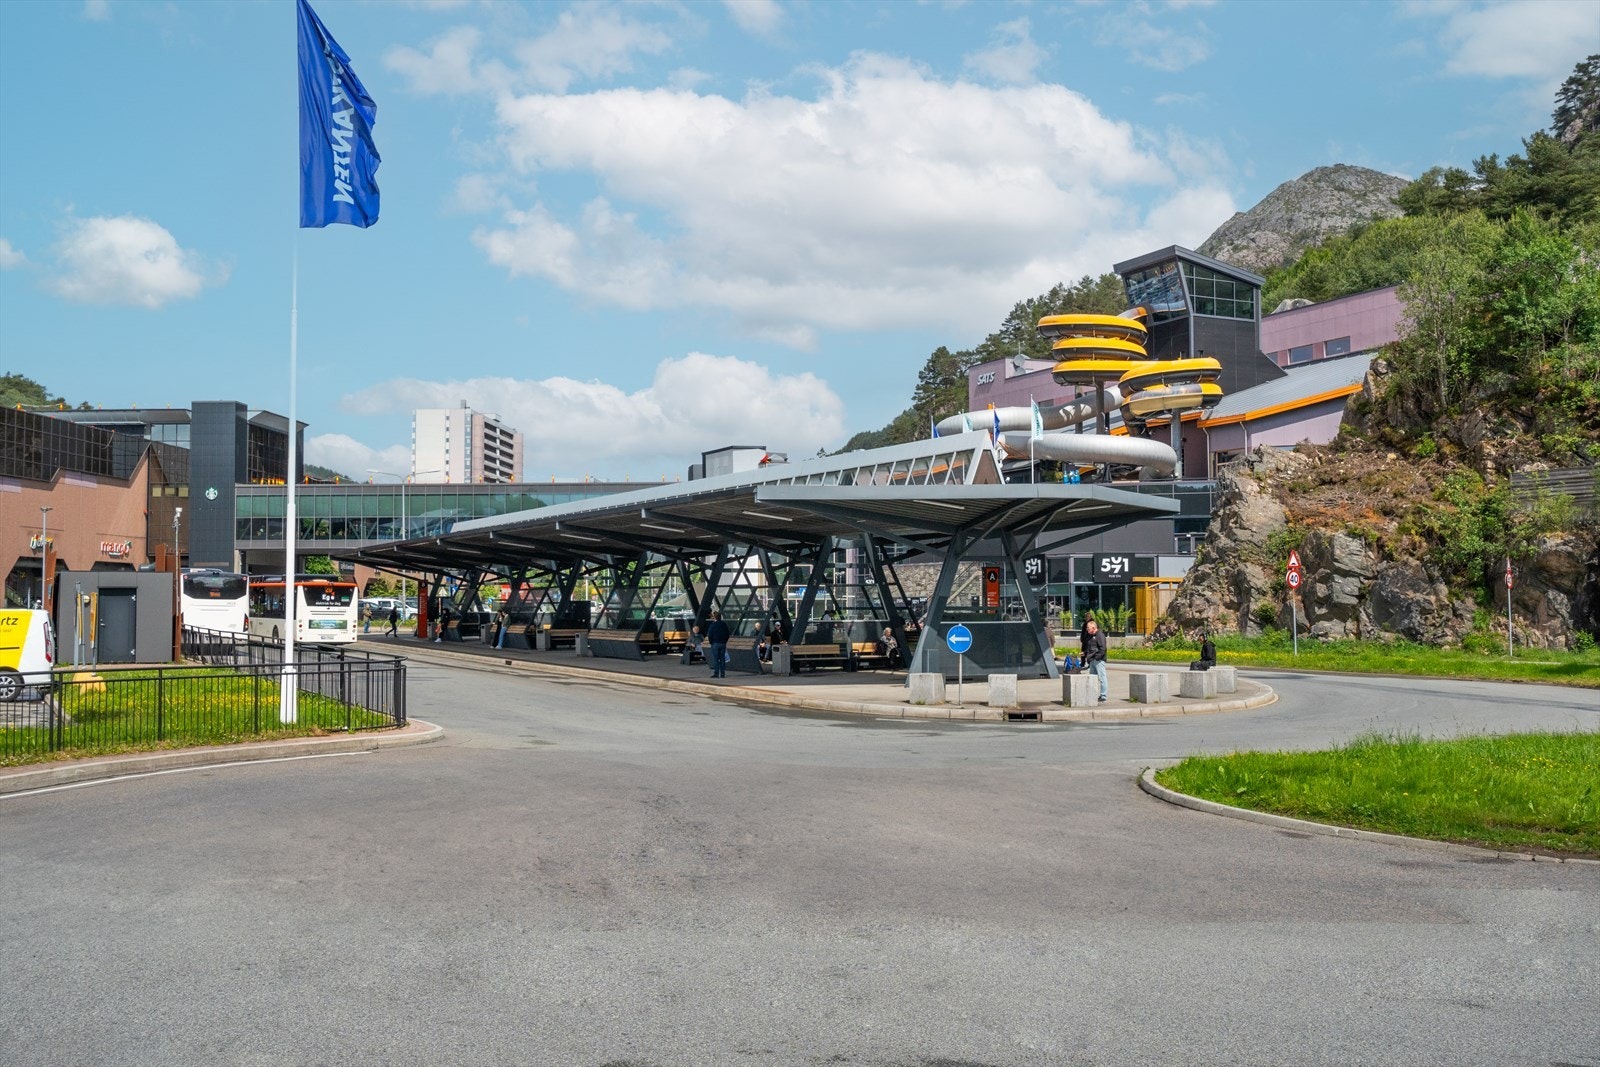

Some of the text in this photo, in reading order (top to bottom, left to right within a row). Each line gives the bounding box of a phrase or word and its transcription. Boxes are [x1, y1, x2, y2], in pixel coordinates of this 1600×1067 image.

[977, 372, 996, 385] SATS
[990, 573, 996, 581] A
[1290, 574, 1299, 583] 40
